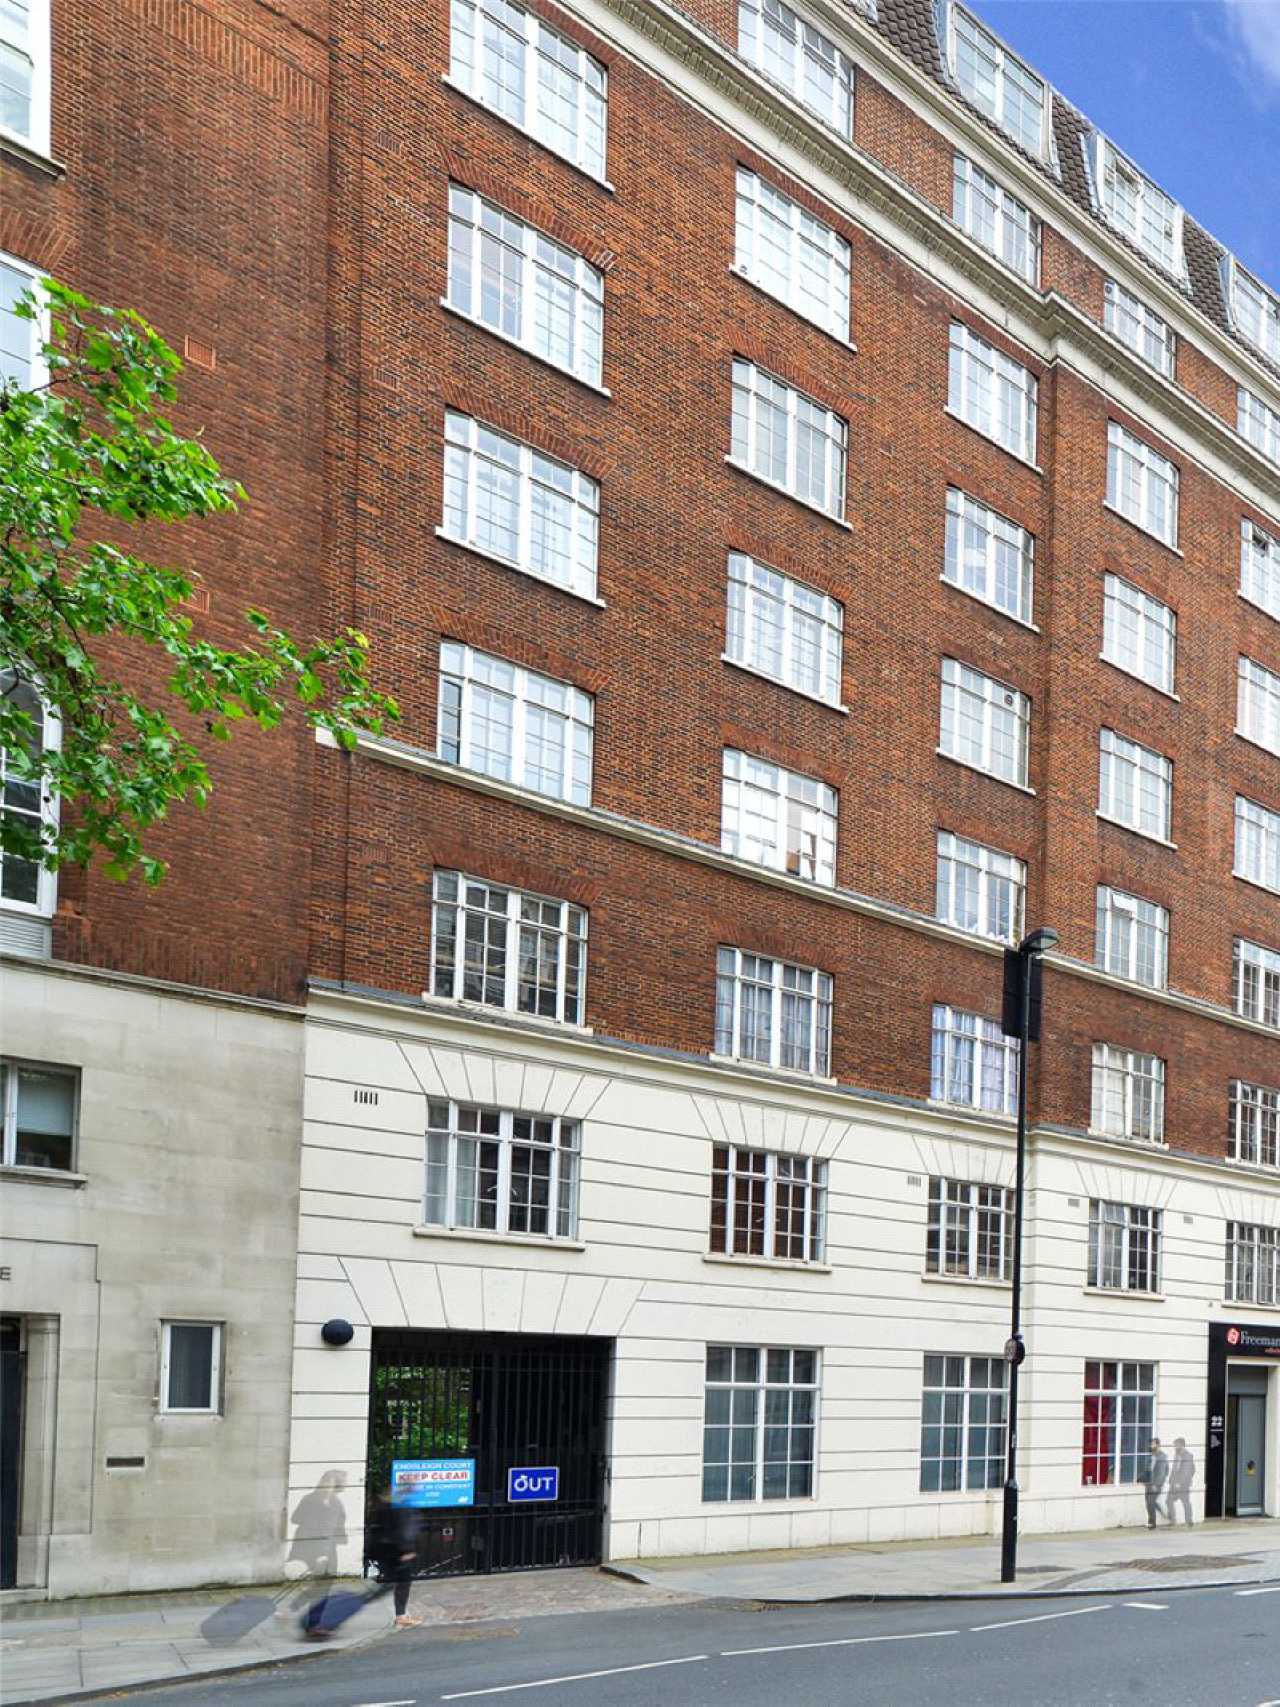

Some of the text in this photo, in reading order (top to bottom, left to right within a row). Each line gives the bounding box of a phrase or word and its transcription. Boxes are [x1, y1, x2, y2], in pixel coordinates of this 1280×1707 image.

[398, 1472, 468, 1482] KEEP CLEAR
[514, 1476, 553, 1492] OUT
